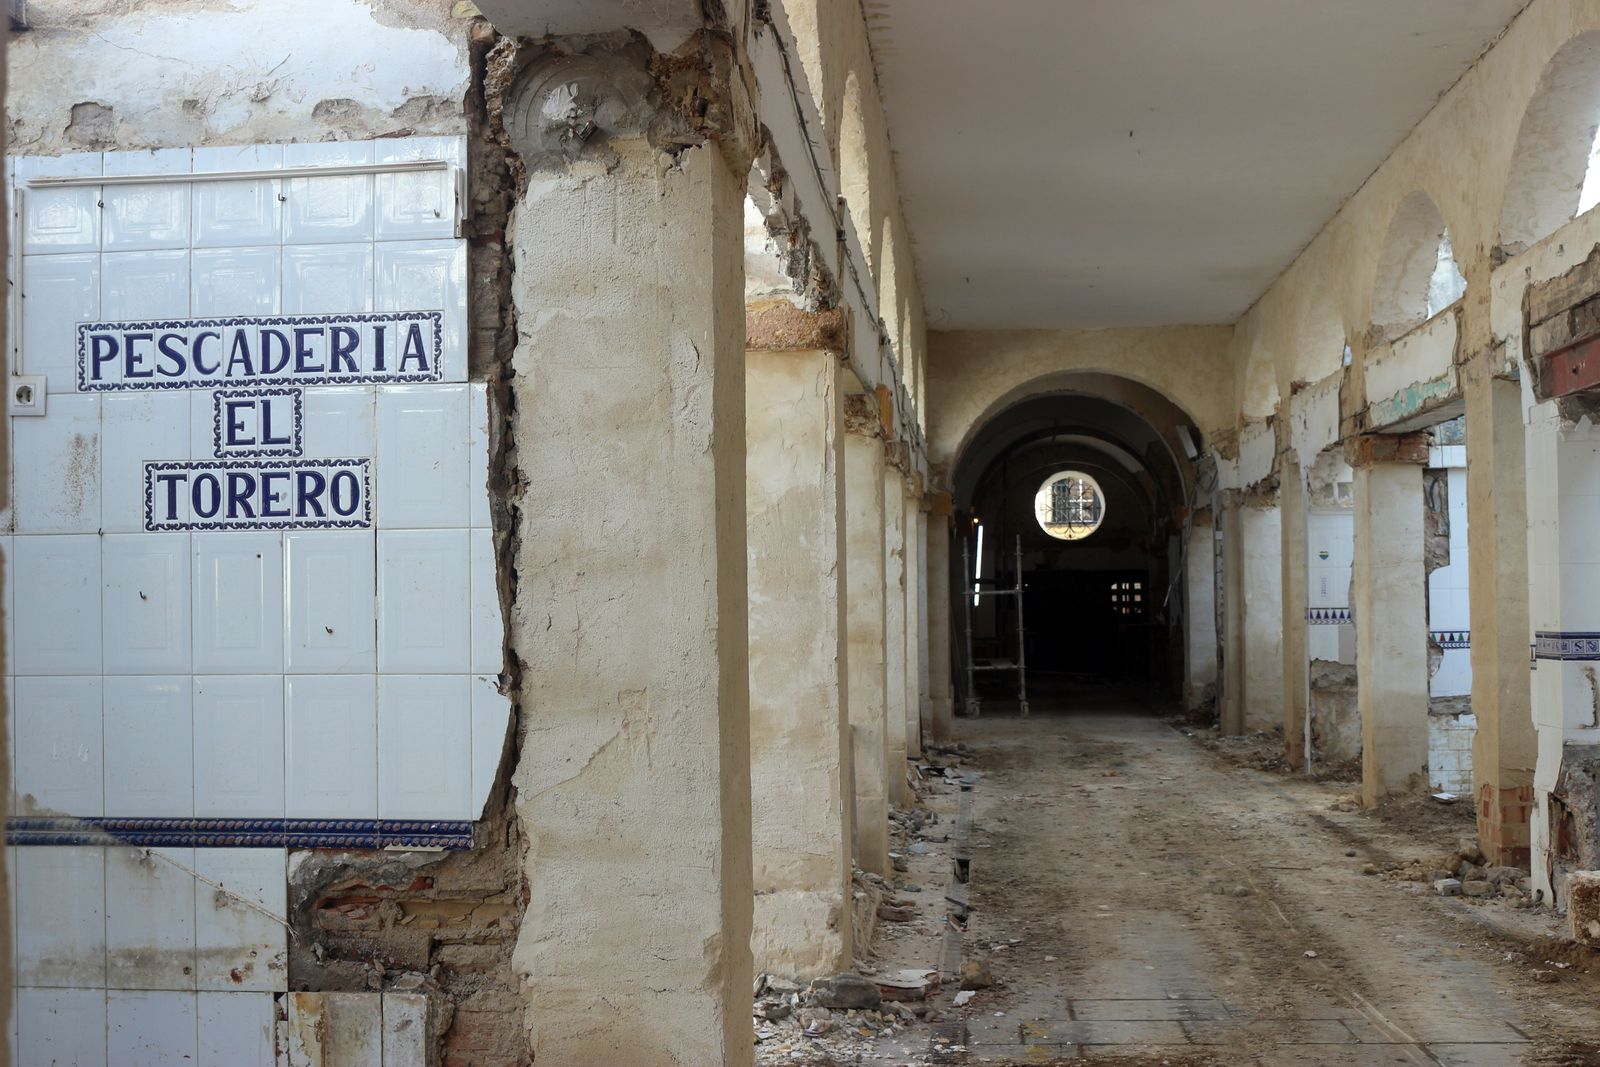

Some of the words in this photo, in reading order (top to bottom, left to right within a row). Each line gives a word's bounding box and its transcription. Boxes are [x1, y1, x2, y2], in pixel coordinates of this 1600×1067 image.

[90, 323, 431, 381] PESCADERIA
[225, 399, 292, 447] EL
[156, 470, 360, 520] TORERO
